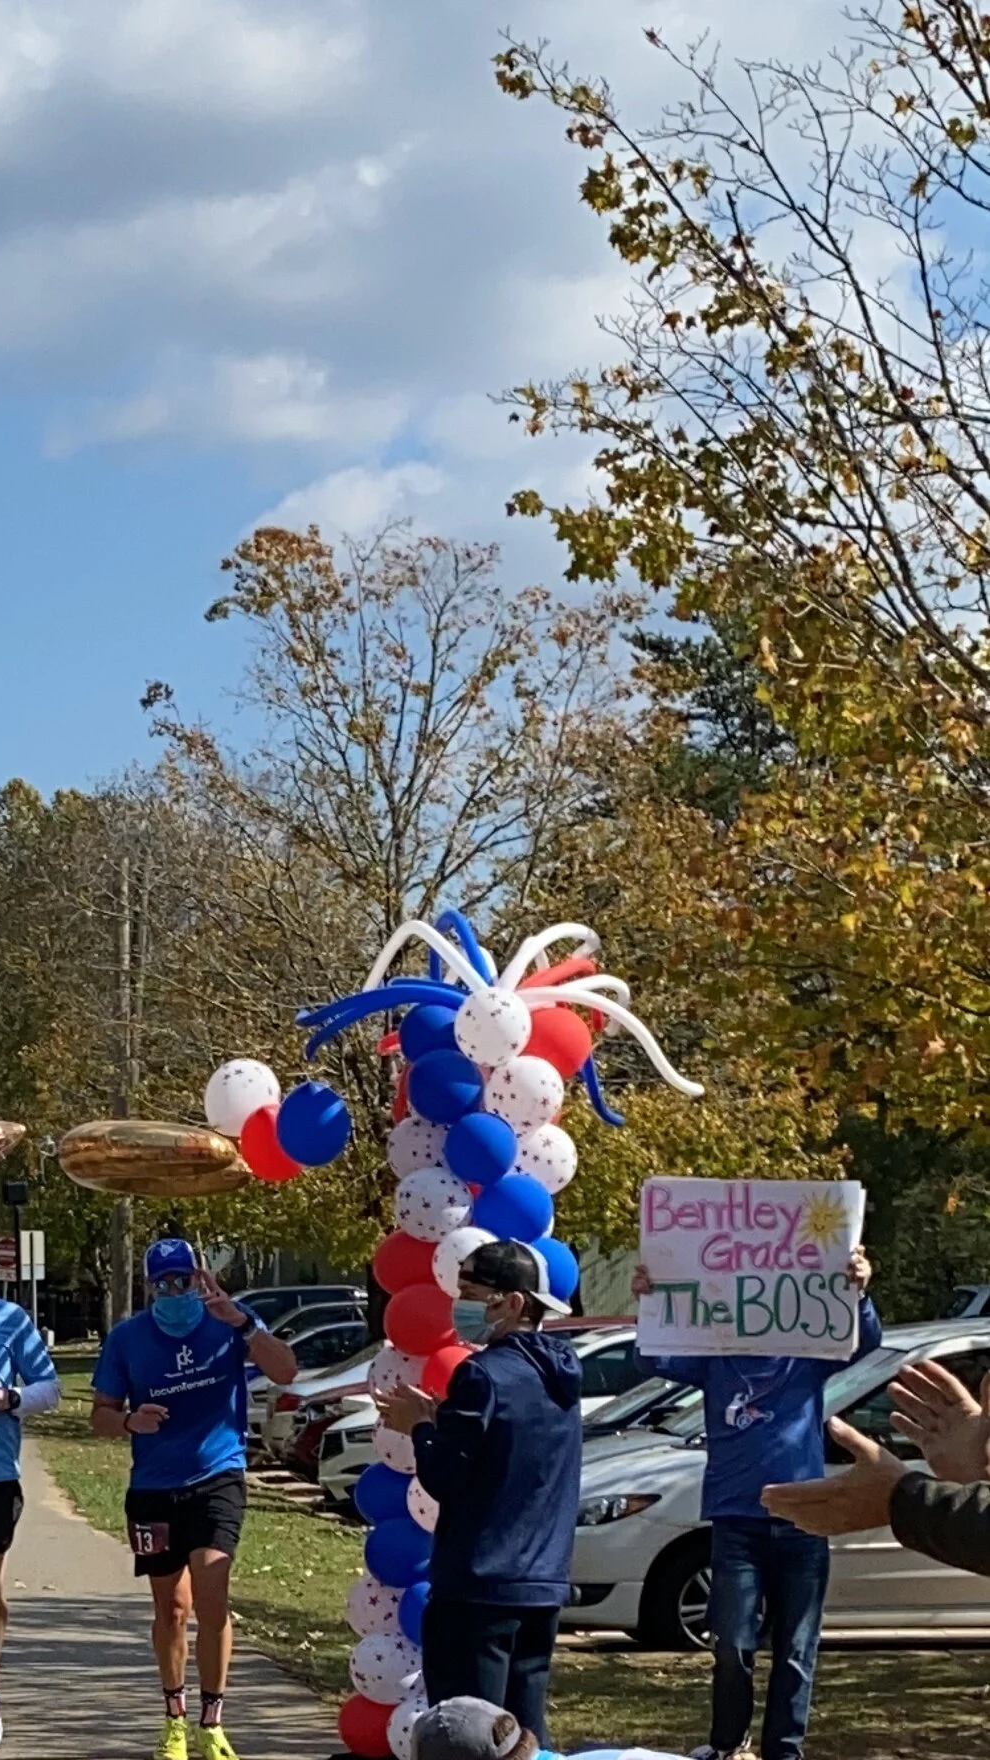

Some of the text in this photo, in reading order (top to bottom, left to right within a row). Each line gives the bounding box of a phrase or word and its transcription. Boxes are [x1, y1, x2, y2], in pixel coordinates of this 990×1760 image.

[647, 1183, 802, 1243] Bentley
[700, 1232, 822, 1272] Grace
[651, 1272, 854, 1342] The BOSS
[135, 1532, 153, 1552] 13
